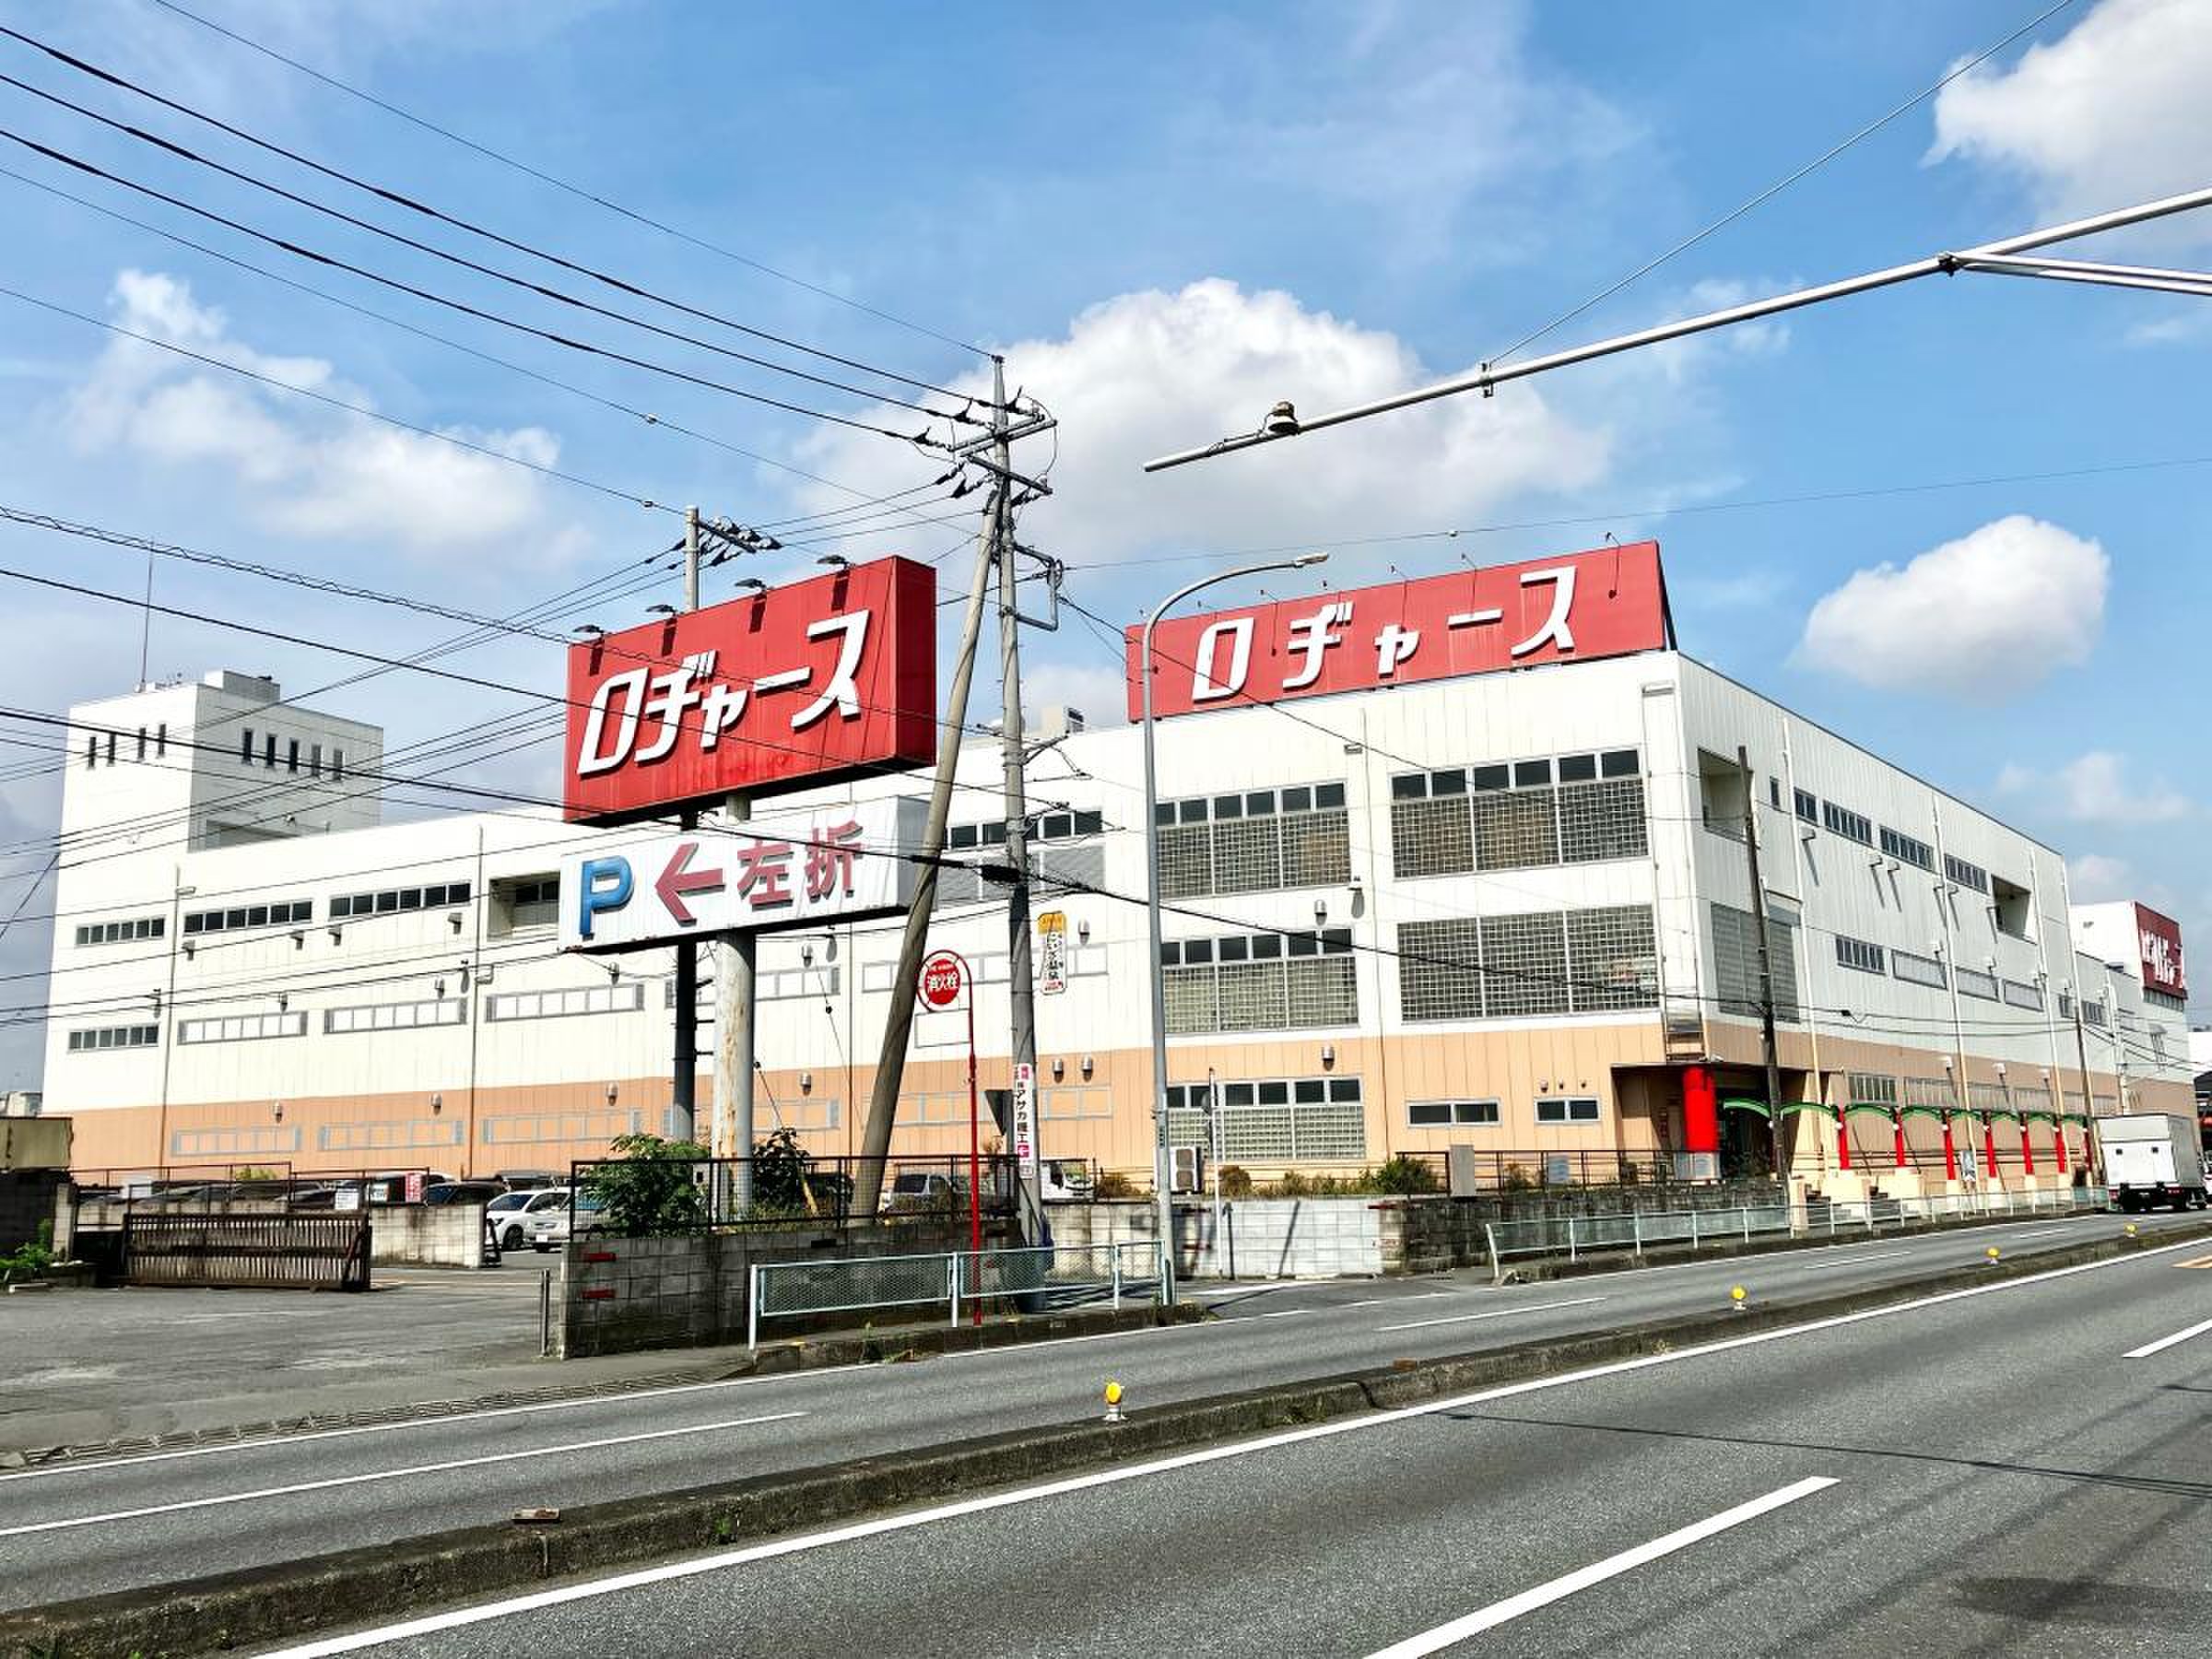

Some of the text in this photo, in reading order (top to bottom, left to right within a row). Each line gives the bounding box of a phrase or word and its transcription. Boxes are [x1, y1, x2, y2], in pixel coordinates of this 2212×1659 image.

[1192, 565, 1577, 703] ロヂャース
[577, 609, 870, 776] ロヂャース
[579, 855, 634, 937] P
[736, 820, 864, 905] 左折
